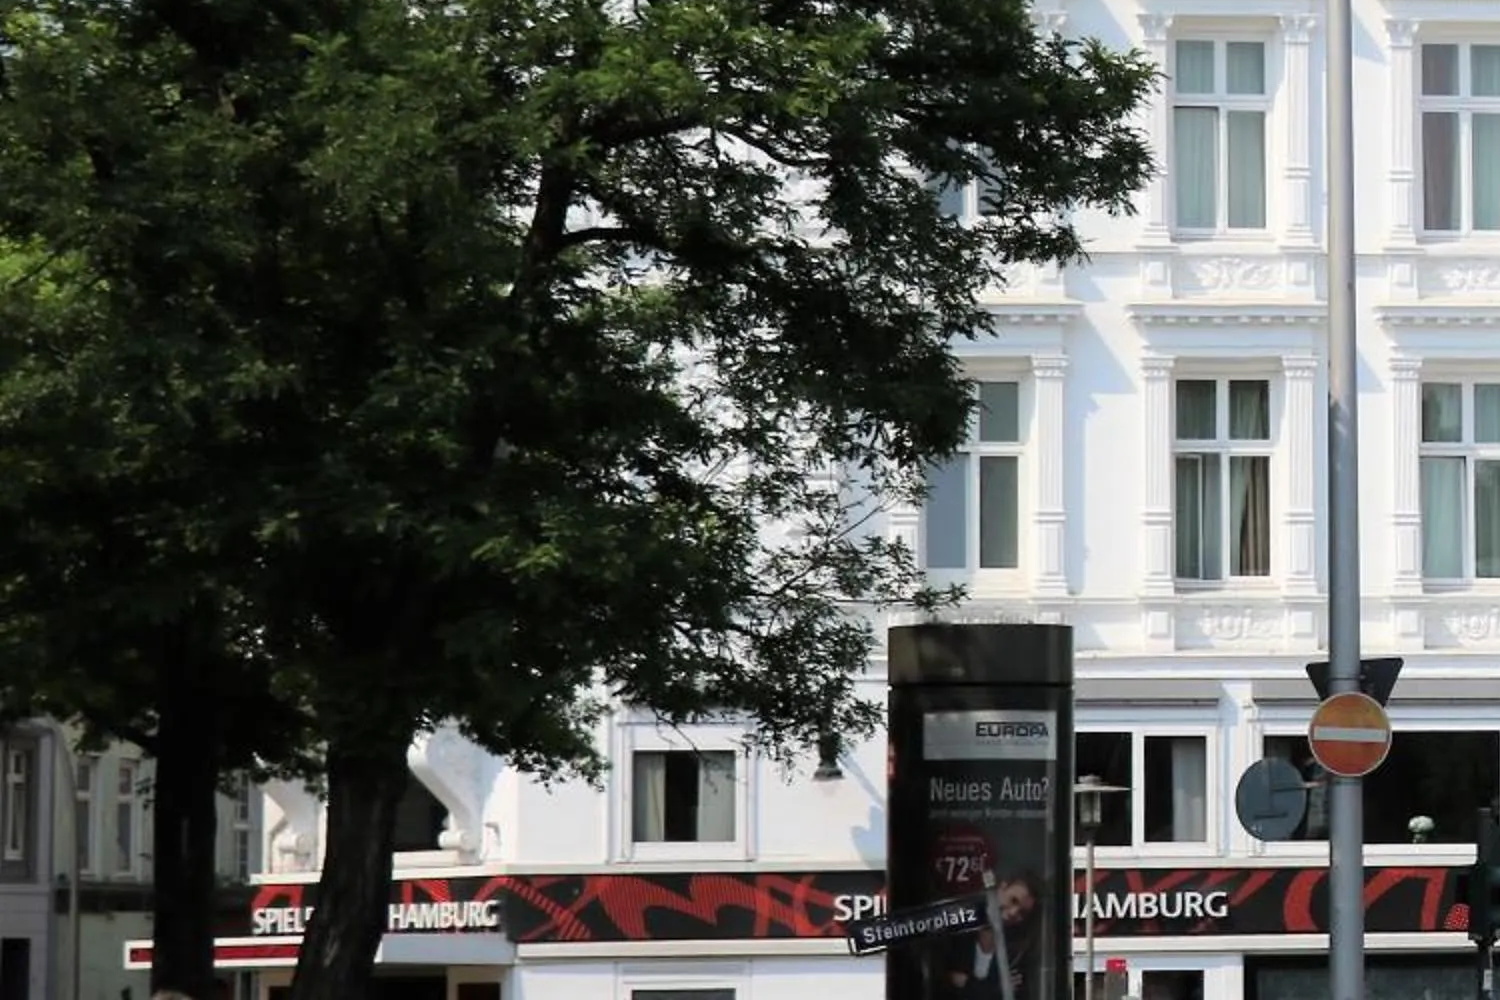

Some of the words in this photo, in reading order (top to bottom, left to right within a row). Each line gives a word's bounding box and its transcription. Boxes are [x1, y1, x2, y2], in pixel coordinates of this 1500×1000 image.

[930, 777, 992, 801] Neues
[1000, 776, 1050, 801] Auto?
[388, 900, 500, 929] HAMBURG
[863, 908, 977, 943] Steintorplatz
